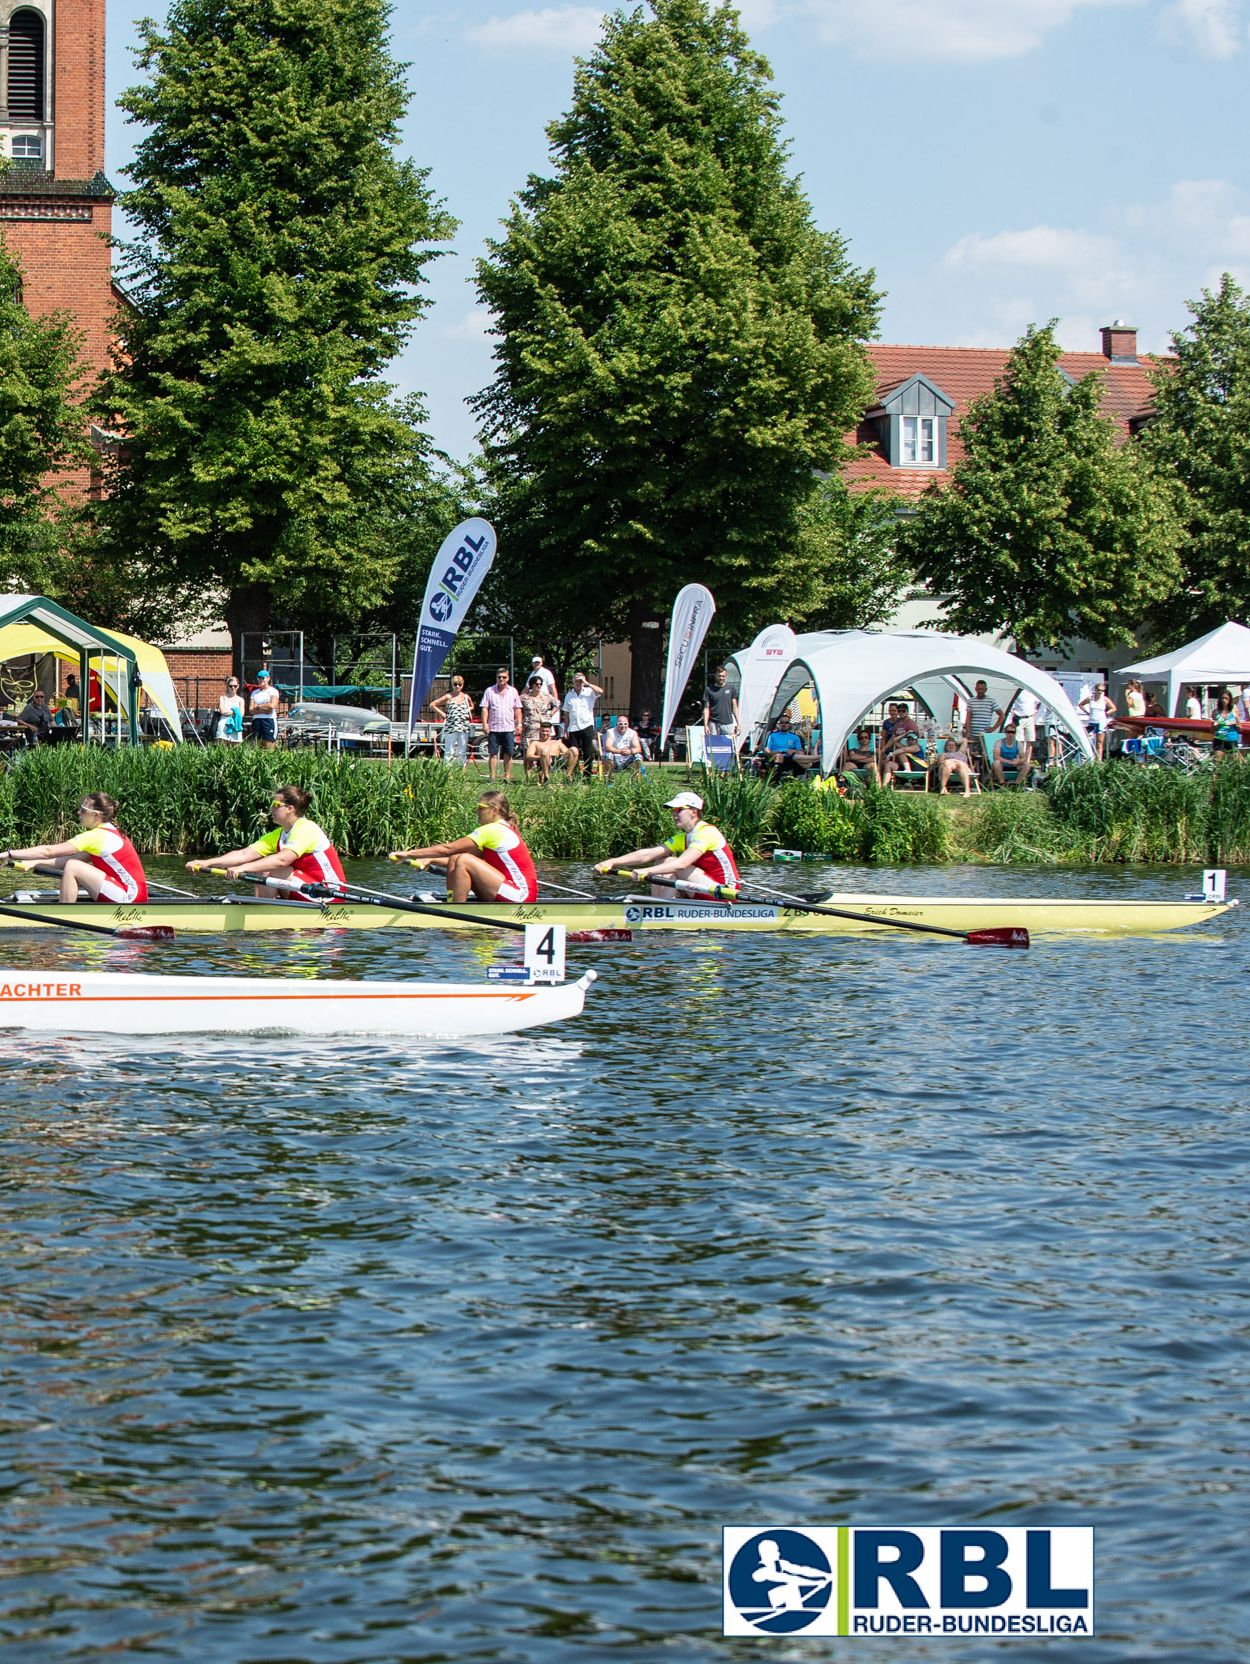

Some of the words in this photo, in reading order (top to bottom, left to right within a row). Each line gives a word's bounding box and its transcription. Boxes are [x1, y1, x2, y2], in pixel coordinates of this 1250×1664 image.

[441, 534, 486, 594] RBL
[455, 541, 490, 598] RUDER-BUNDESLIGA
[421, 629, 442, 639] STARK.
[419, 645, 433, 653] GUT.
[420, 637, 449, 648] SCHNELL.
[1208, 872, 1216, 892] 1
[108, 905, 143, 922] Melitta
[317, 905, 351, 922] Melitta
[510, 905, 543, 920] Melitta
[643, 907, 674, 918] RBL
[677, 909, 775, 919] RUDER-BUNDESLIGA
[863, 907, 887, 916] Erich
[889, 907, 924, 916] Domeier
[536, 927, 555, 965] 4
